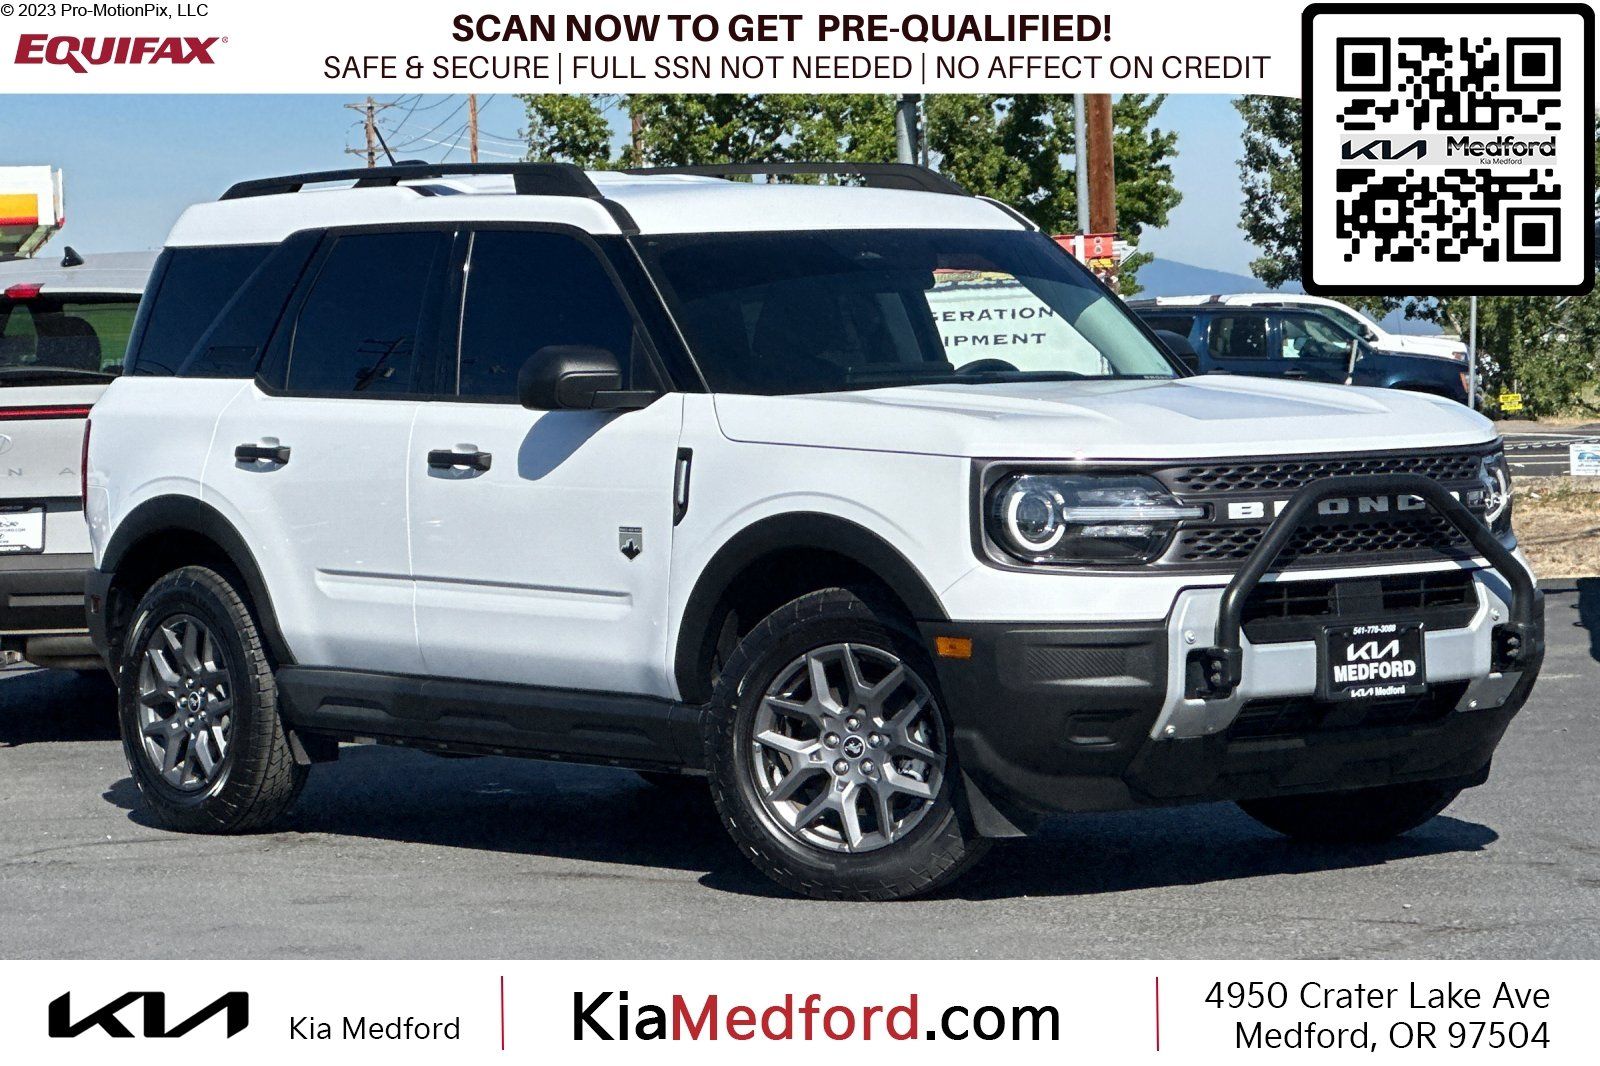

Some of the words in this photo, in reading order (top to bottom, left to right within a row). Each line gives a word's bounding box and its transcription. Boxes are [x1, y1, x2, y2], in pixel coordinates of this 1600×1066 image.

[944, 333, 1047, 347] IPMENT
[1228, 492, 1460, 520] BONC
[1347, 639, 1400, 661] KIA
[1334, 660, 1416, 683] MEDFORD
[1375, 685, 1406, 697] Medford
